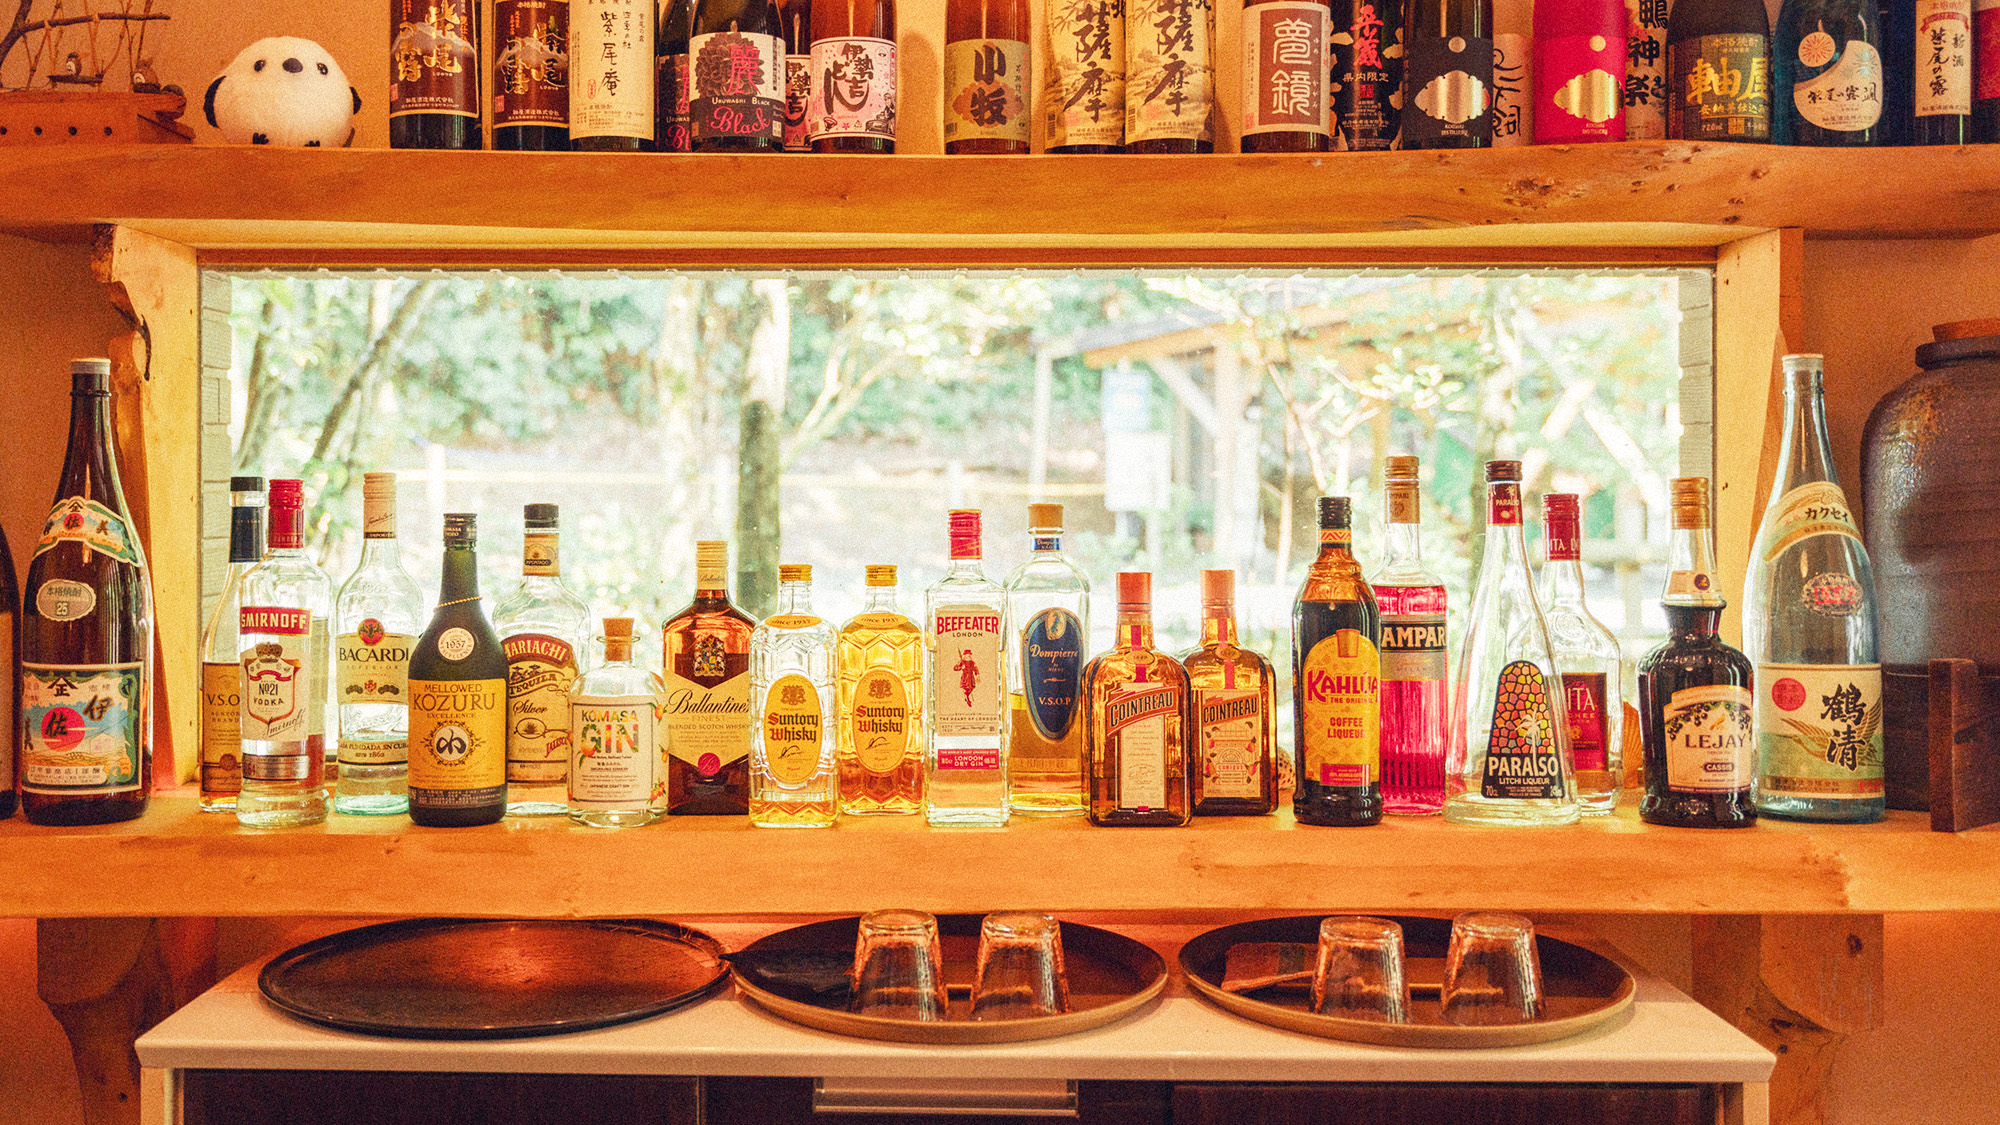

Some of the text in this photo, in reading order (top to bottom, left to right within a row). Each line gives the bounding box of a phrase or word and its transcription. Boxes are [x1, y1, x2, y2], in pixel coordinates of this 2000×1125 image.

[597, 11, 621, 97] 紫尾庵
[1062, 2, 1113, 124] 薩摩
[1142, 0, 1194, 117] 薩摩
[726, 44, 762, 96] 麗
[840, 43, 874, 98] 伊勢吉
[1342, 71, 1389, 83] 県内限定
[970, 44, 1007, 127] 小牧
[1686, 56, 1769, 105] 軸屋
[709, 106, 771, 135] Black
[56, 602, 68, 616] 25
[240, 612, 308, 630] SMIRNOFF
[937, 616, 999, 636] BEEFEATER
[339, 647, 409, 663] BACARDI
[1029, 643, 1080, 664] Dompierre
[423, 683, 483, 694] MELLOWED
[510, 673, 558, 696] TEQUILA
[1307, 669, 1379, 703] KAHLÚA
[253, 697, 285, 706] VODKA
[413, 692, 496, 712] KOZURU
[512, 699, 549, 716] Silver
[1110, 691, 1174, 728] COINTREAU
[1203, 697, 1258, 724] COINTREAU
[581, 710, 639, 723] KOMASA
[691, 714, 726, 722] FINEST
[767, 712, 819, 728] Suntory
[855, 705, 904, 720] Suntory
[1329, 717, 1364, 727] COFFEE
[44, 711, 69, 739] 佐
[857, 719, 903, 735] Whisky
[1819, 682, 1867, 772] 鶴清
[580, 723, 639, 758] GIN
[769, 727, 817, 744] Whisky
[1684, 733, 1747, 749] LEJAY
[1487, 756, 1560, 777] PARAISO
[1498, 777, 1550, 785] LITCHI LIQUEUR
